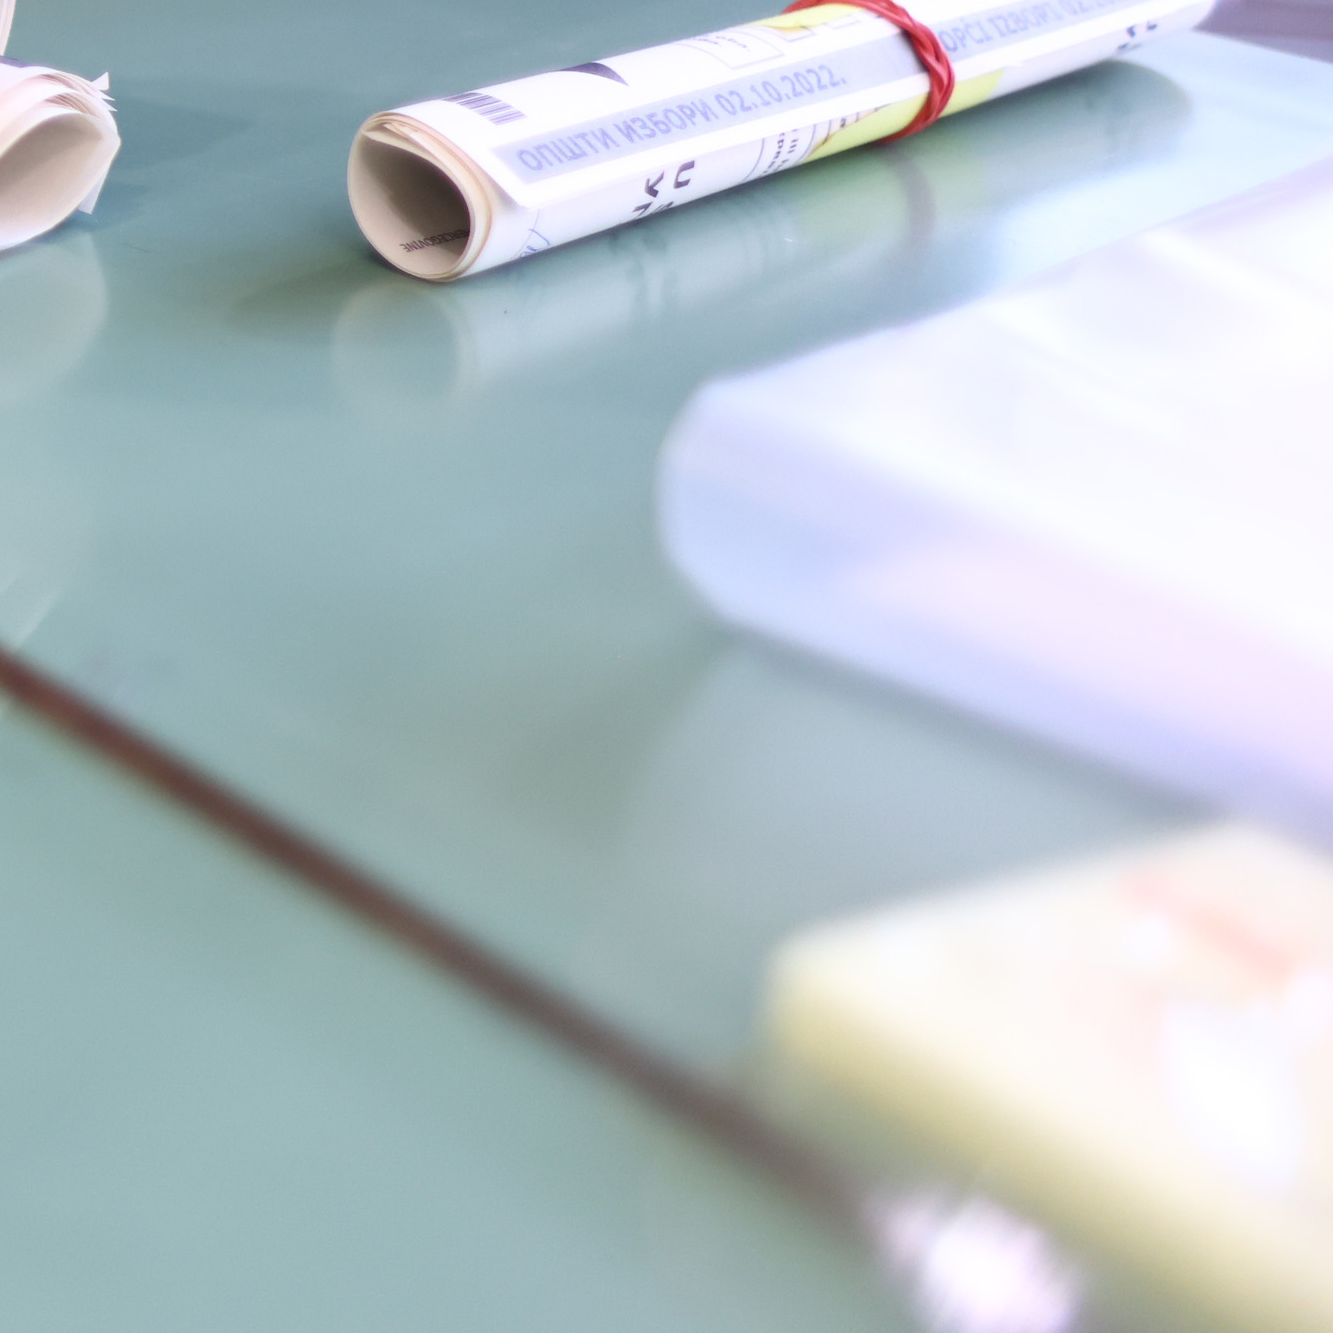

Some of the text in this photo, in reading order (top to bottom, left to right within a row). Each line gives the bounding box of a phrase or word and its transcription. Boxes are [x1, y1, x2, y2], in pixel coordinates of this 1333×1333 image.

[939, 16, 993, 54] OPĆI
[994, 0, 1064, 38] IZBORI
[515, 63, 848, 172] ОПШТИ ИЗБОРИ 02.10.2022.
